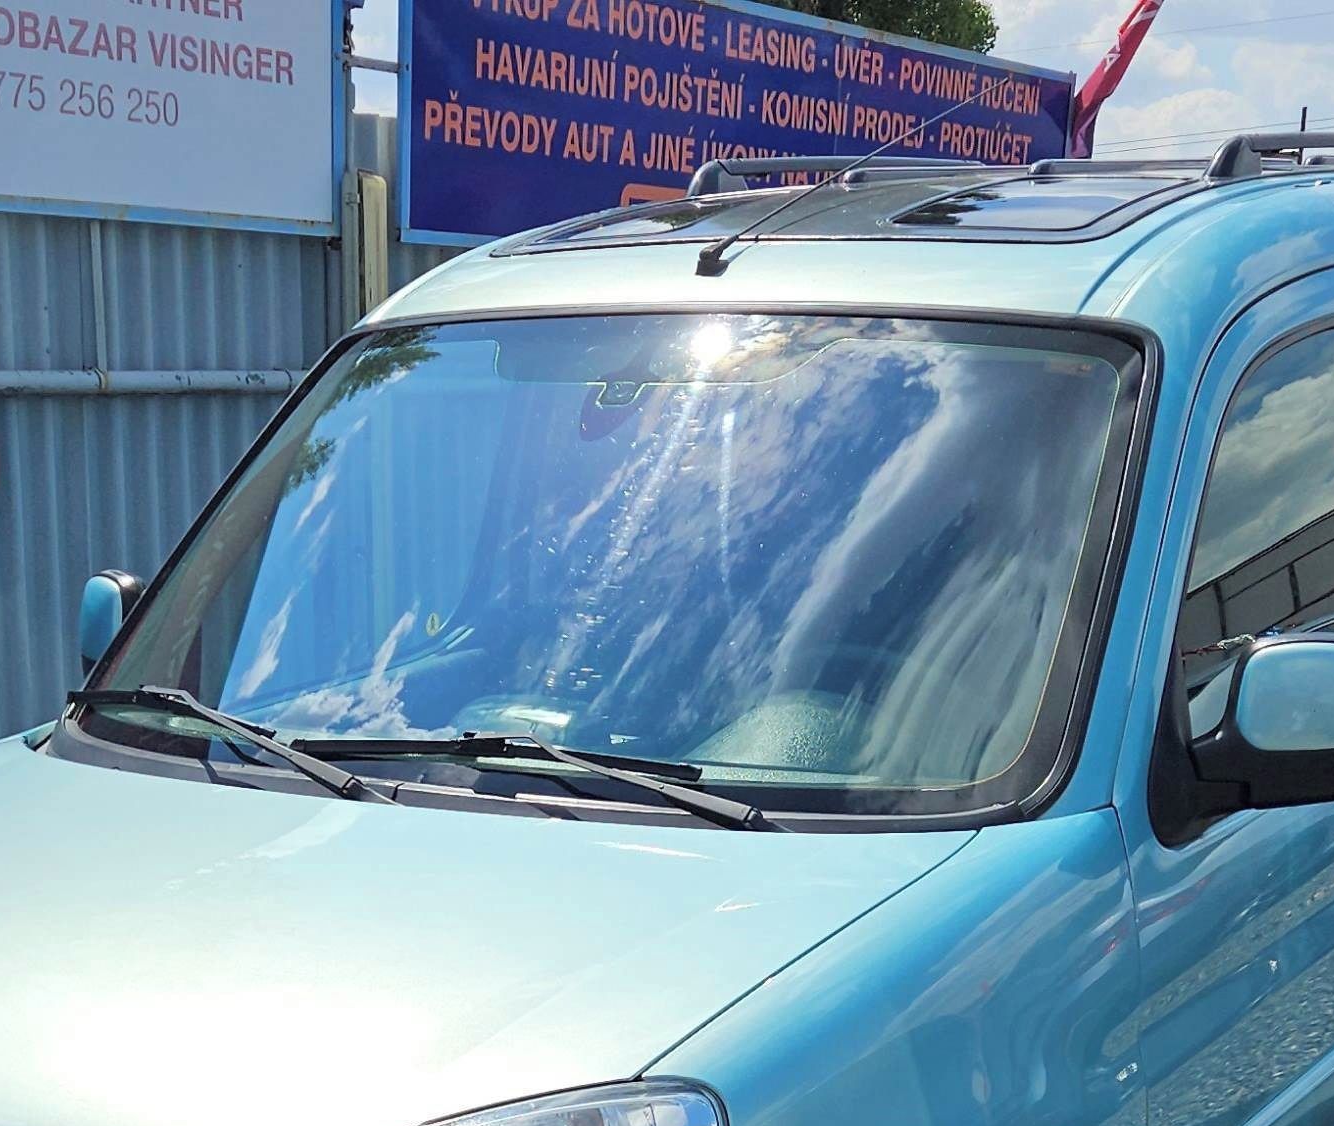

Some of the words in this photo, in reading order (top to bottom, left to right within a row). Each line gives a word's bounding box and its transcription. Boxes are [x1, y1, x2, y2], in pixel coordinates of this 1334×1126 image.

[148, 30, 295, 85] VISINGER
[608, 0, 705, 52] HOTOVÉ
[725, 20, 816, 73] LEASING
[834, 35, 884, 87] ÚVĚR
[899, 58, 977, 104] POVINNÉ
[59, 78, 115, 119] 256
[127, 88, 179, 126] 250
[424, 90, 557, 156] PŘEVODY
[563, 121, 614, 163] AUT
[619, 129, 636, 167] A
[643, 125, 696, 174] JINÉ
[475, 38, 619, 100] HAVARIJNÍ
[624, 63, 745, 120] POJIŠTĚNÍ
[761, 89, 850, 136] KOMISNÍ
[852, 106, 925, 149] PRODEJ
[939, 121, 1032, 165] PROTIÚČET
